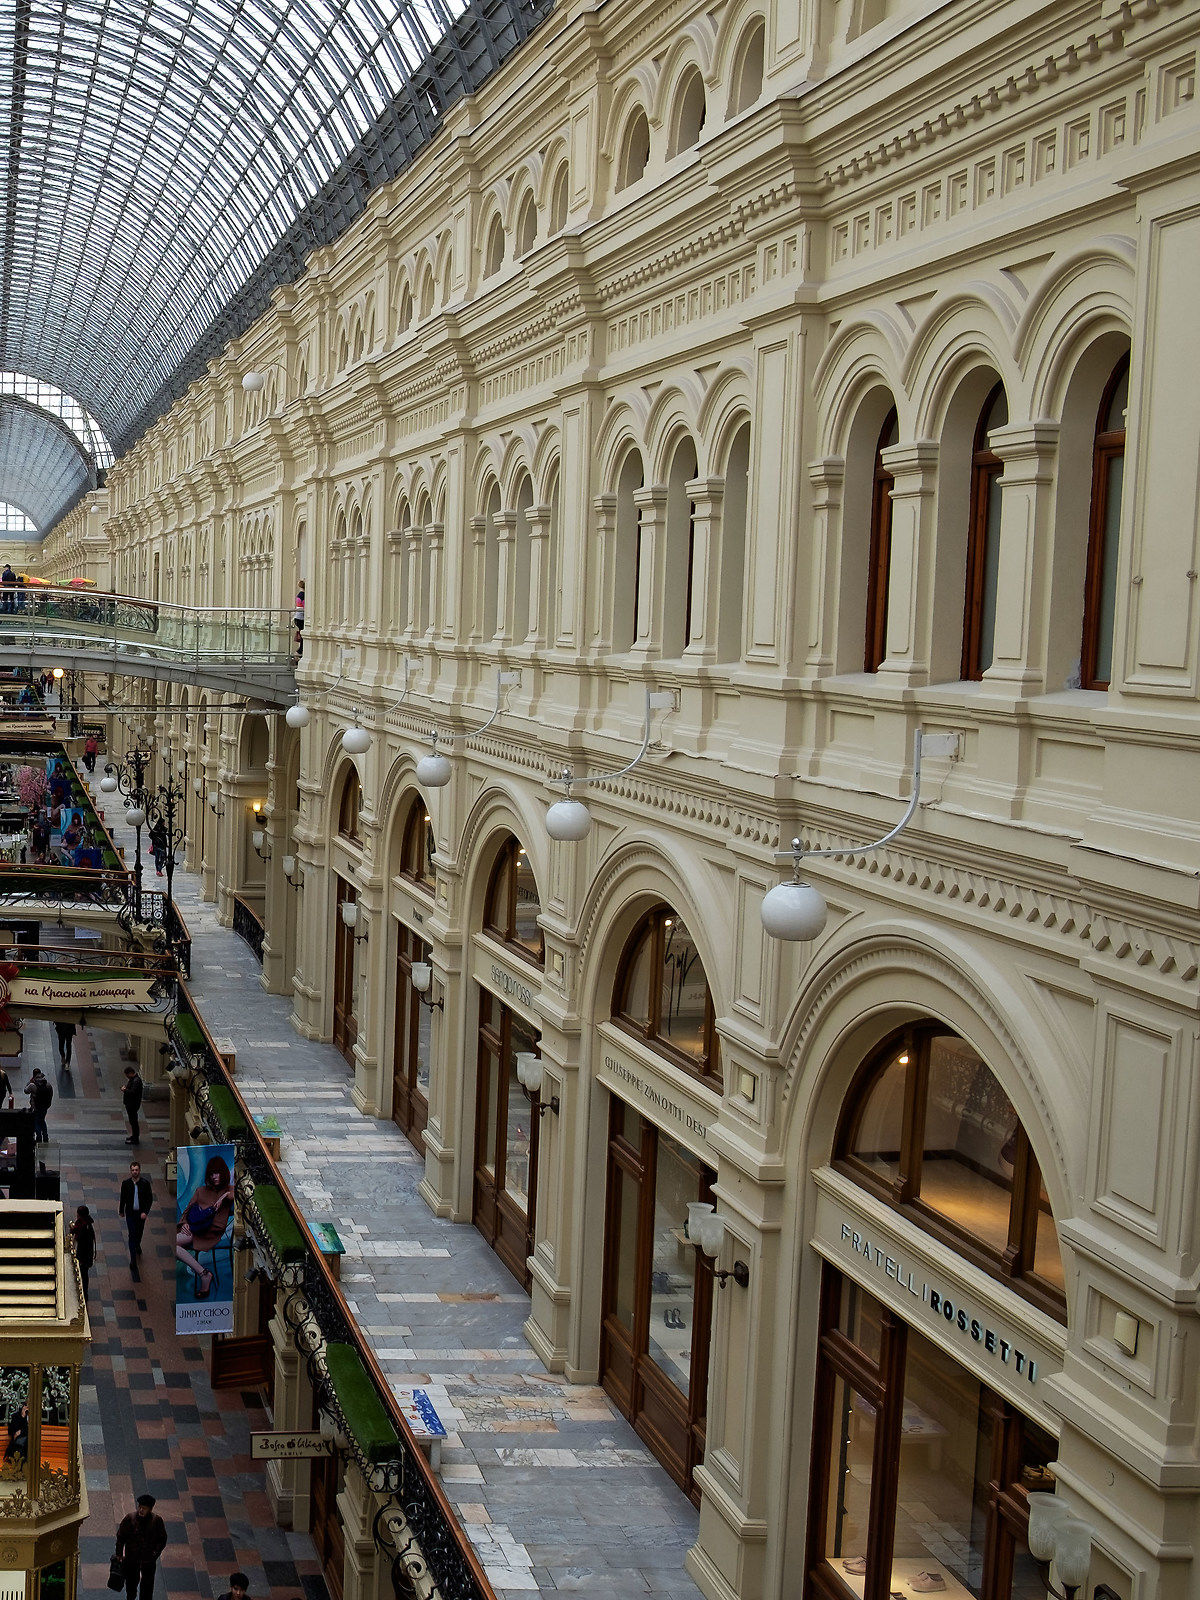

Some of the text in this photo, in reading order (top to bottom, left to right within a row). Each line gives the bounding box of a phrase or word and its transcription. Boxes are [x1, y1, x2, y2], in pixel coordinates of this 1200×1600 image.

[24, 985, 136, 1001] на Красной площади
[604, 1056, 642, 1091] GIUSEPPE
[644, 1083, 685, 1122] ZANOTTI
[179, 1307, 230, 1319] JIMMY CHOO
[930, 1288, 1038, 1384] ROSSETTI
